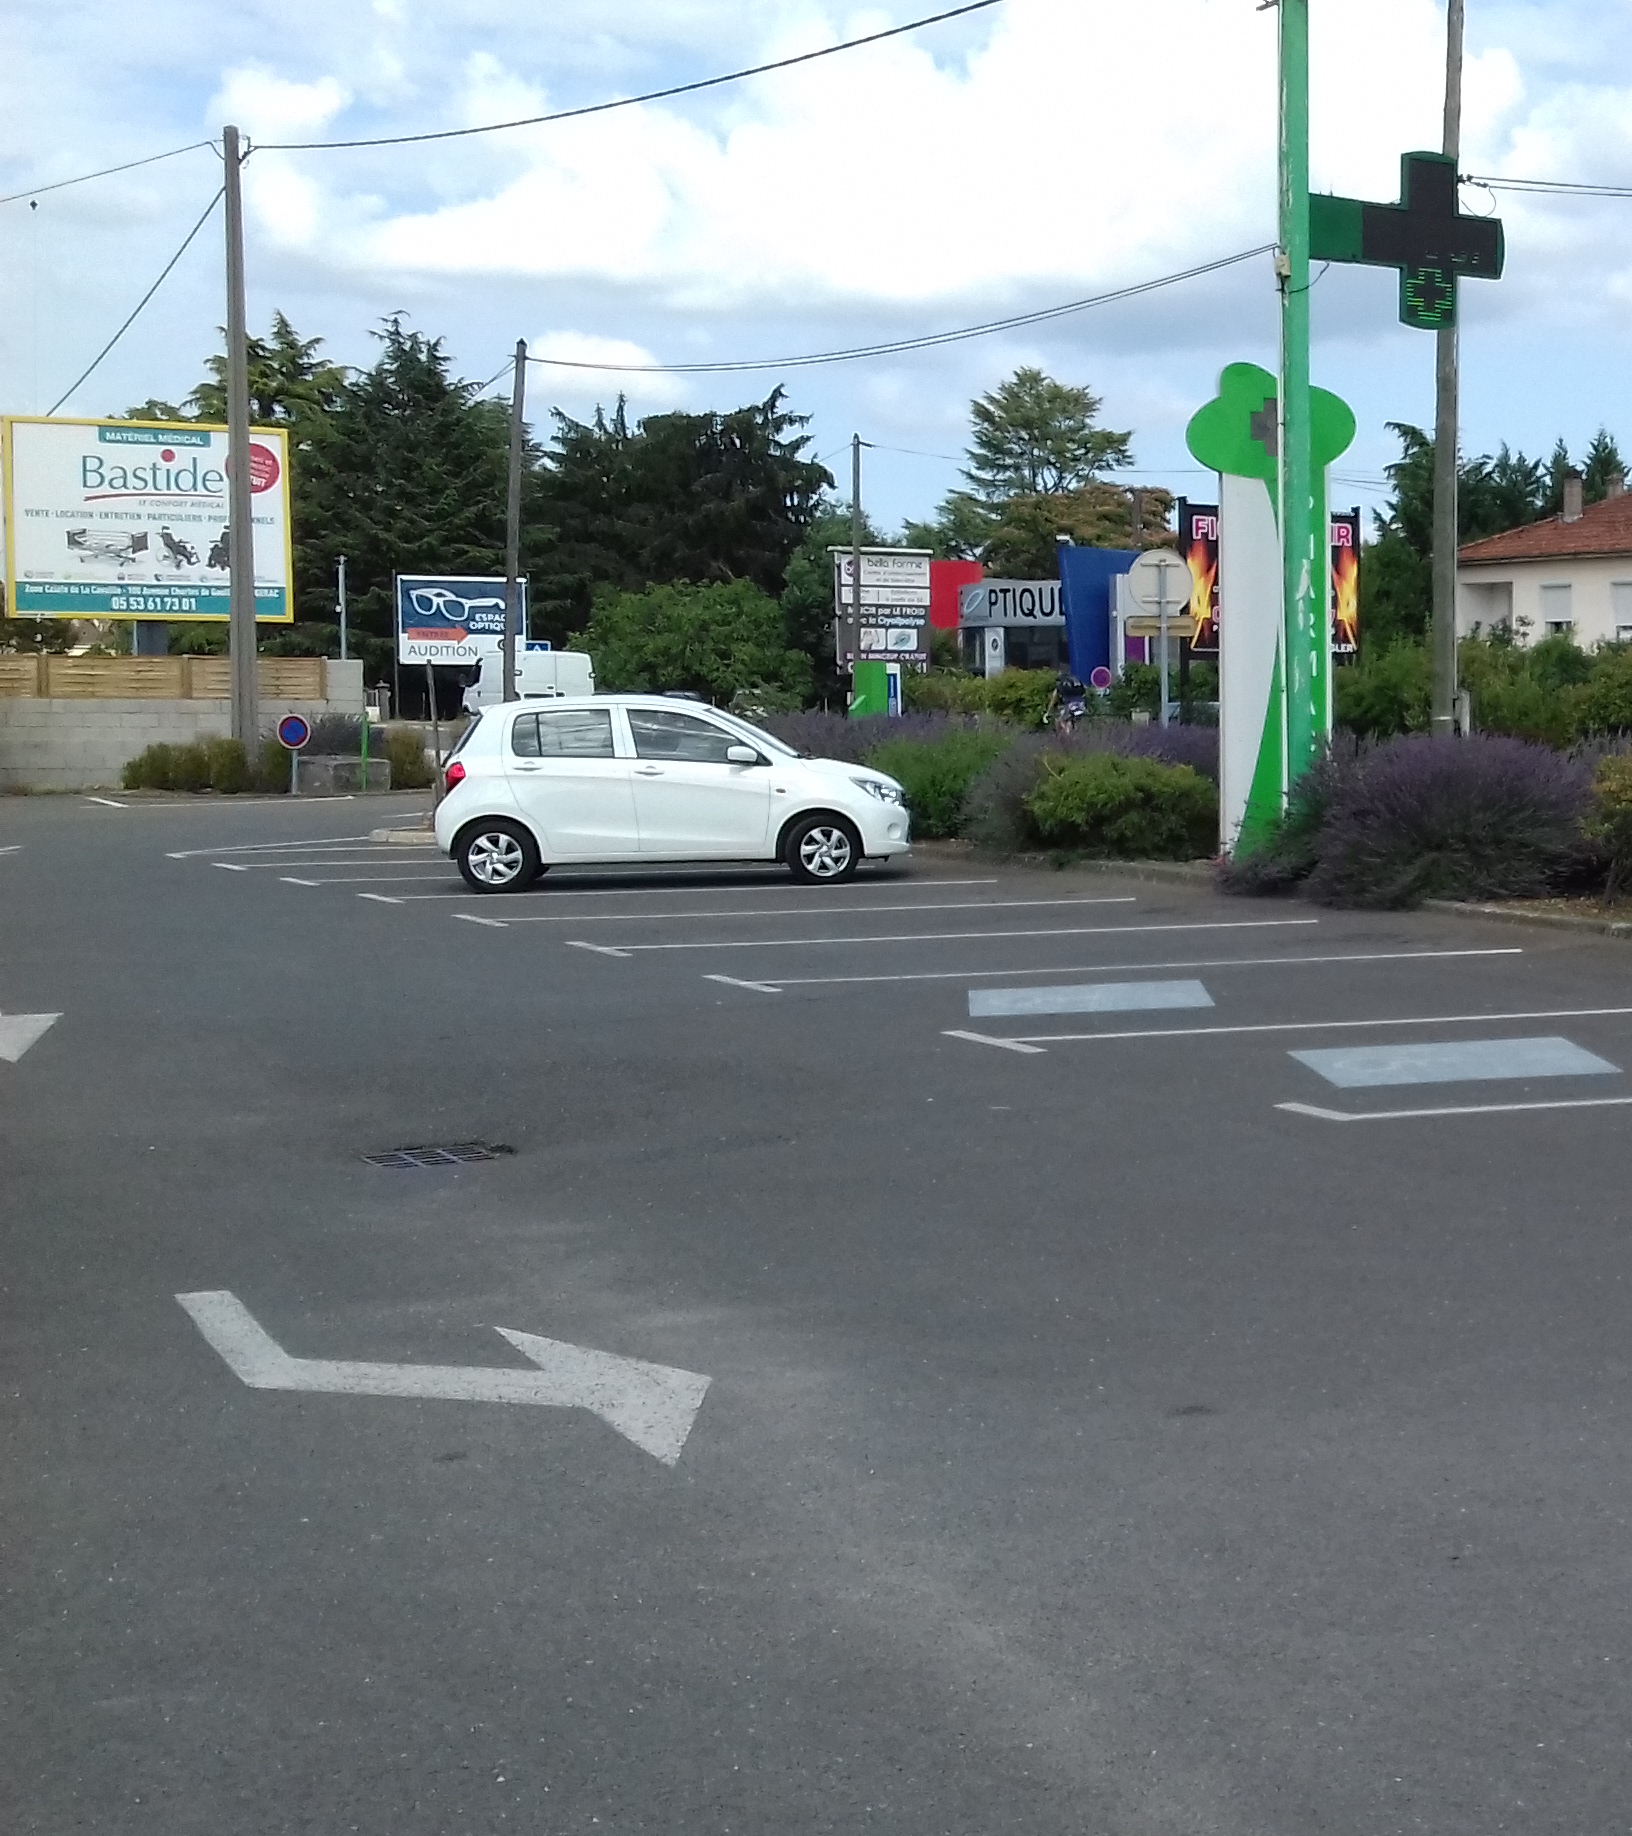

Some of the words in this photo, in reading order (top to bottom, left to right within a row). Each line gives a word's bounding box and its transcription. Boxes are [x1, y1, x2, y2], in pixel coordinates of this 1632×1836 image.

[81, 449, 225, 494] Bastide
[25, 508, 50, 518] VENTE
[55, 510, 94, 520] LOCATION
[99, 512, 142, 521] ENTRETIEN
[147, 513, 203, 523] PARTICULIERS
[892, 558, 923, 569] forme
[111, 597, 127, 610] 05
[128, 597, 145, 610] 53
[146, 598, 161, 611] 61
[163, 598, 180, 611] 73
[181, 599, 197, 611] 01
[474, 613, 506, 622] ESPAC
[892, 607, 901, 615] LE
[902, 607, 926, 616] FROID
[408, 645, 478, 657] AUDITION
